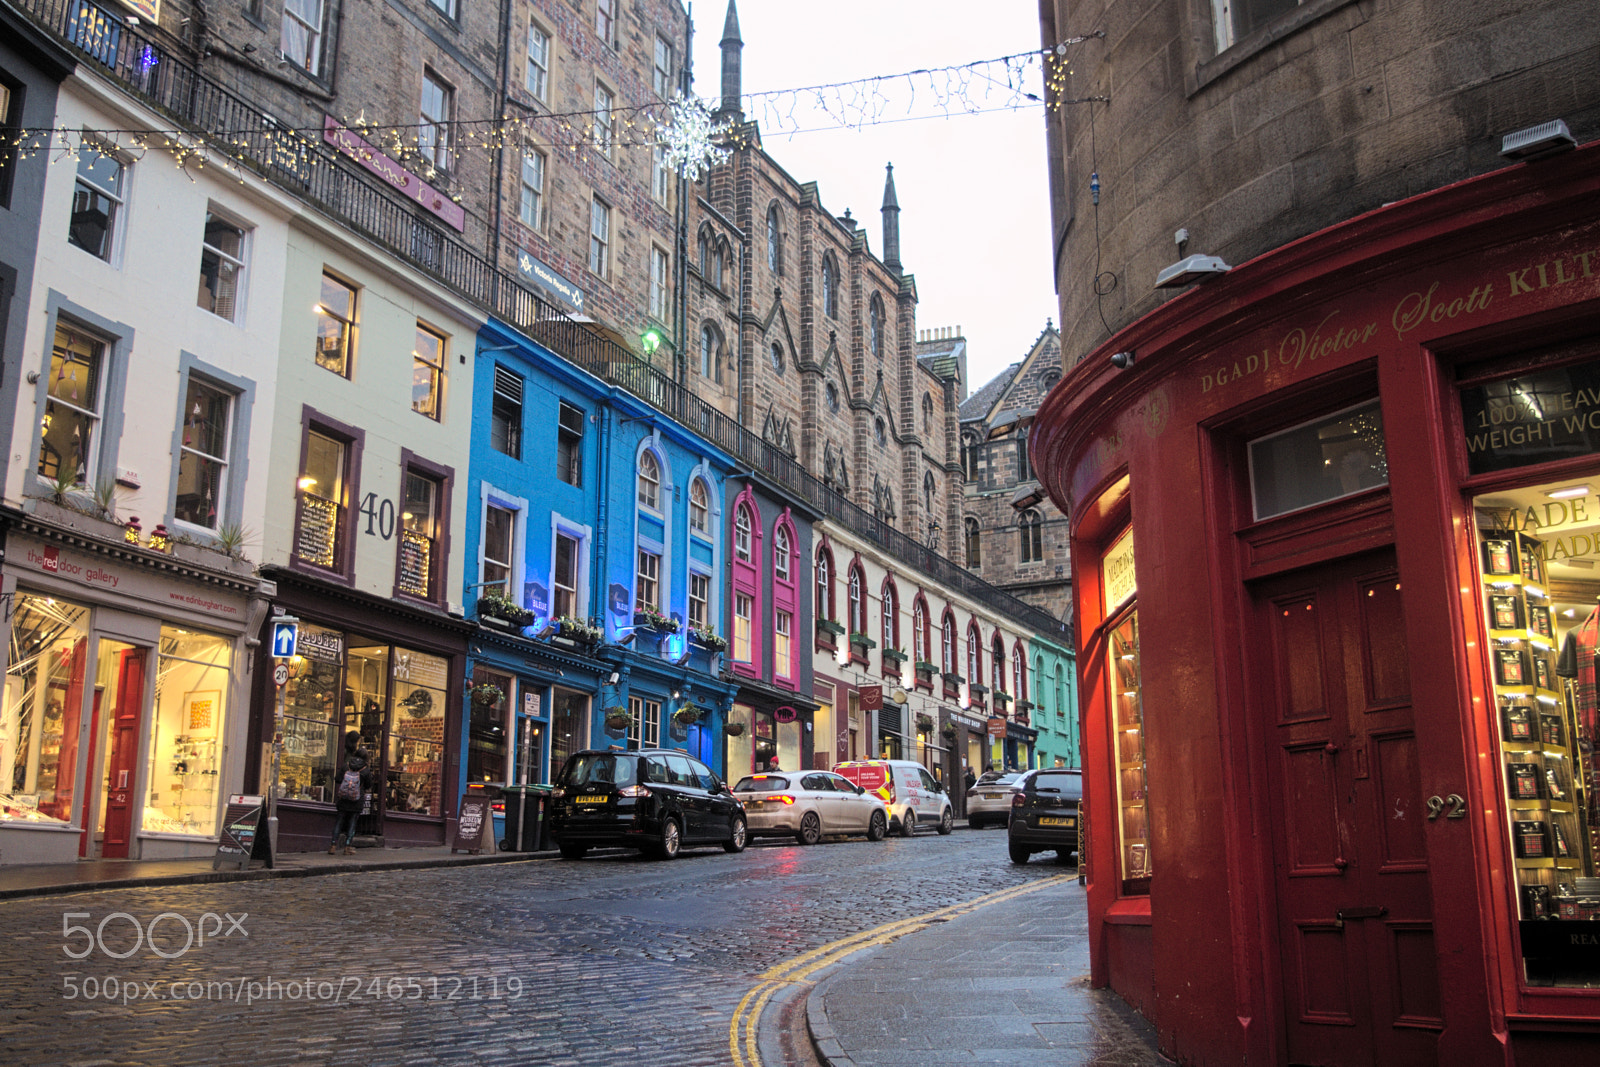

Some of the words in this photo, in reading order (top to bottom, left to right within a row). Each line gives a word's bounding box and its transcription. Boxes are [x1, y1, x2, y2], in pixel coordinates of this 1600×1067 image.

[534, 264, 553, 284] Victoria
[553, 277, 571, 296] Regalia
[1279, 309, 1379, 370] Victor
[1392, 281, 1494, 342] Scott
[1477, 403, 1536, 428] 100%
[1465, 419, 1556, 453] WEIGHT
[359, 491, 395, 541] 40
[1491, 497, 1589, 536] MADE
[27, 549, 42, 565] the
[43, 555, 57, 569] red
[59, 558, 82, 575] door
[85, 567, 119, 587] gallery
[169, 592, 237, 614] www.edinburghart.com
[275, 669, 288, 680] 20
[957, 714, 971, 726] WHISKY
[971, 720, 981, 728] SHOP
[116, 793, 126, 803] 42
[1426, 793, 1466, 819] 92
